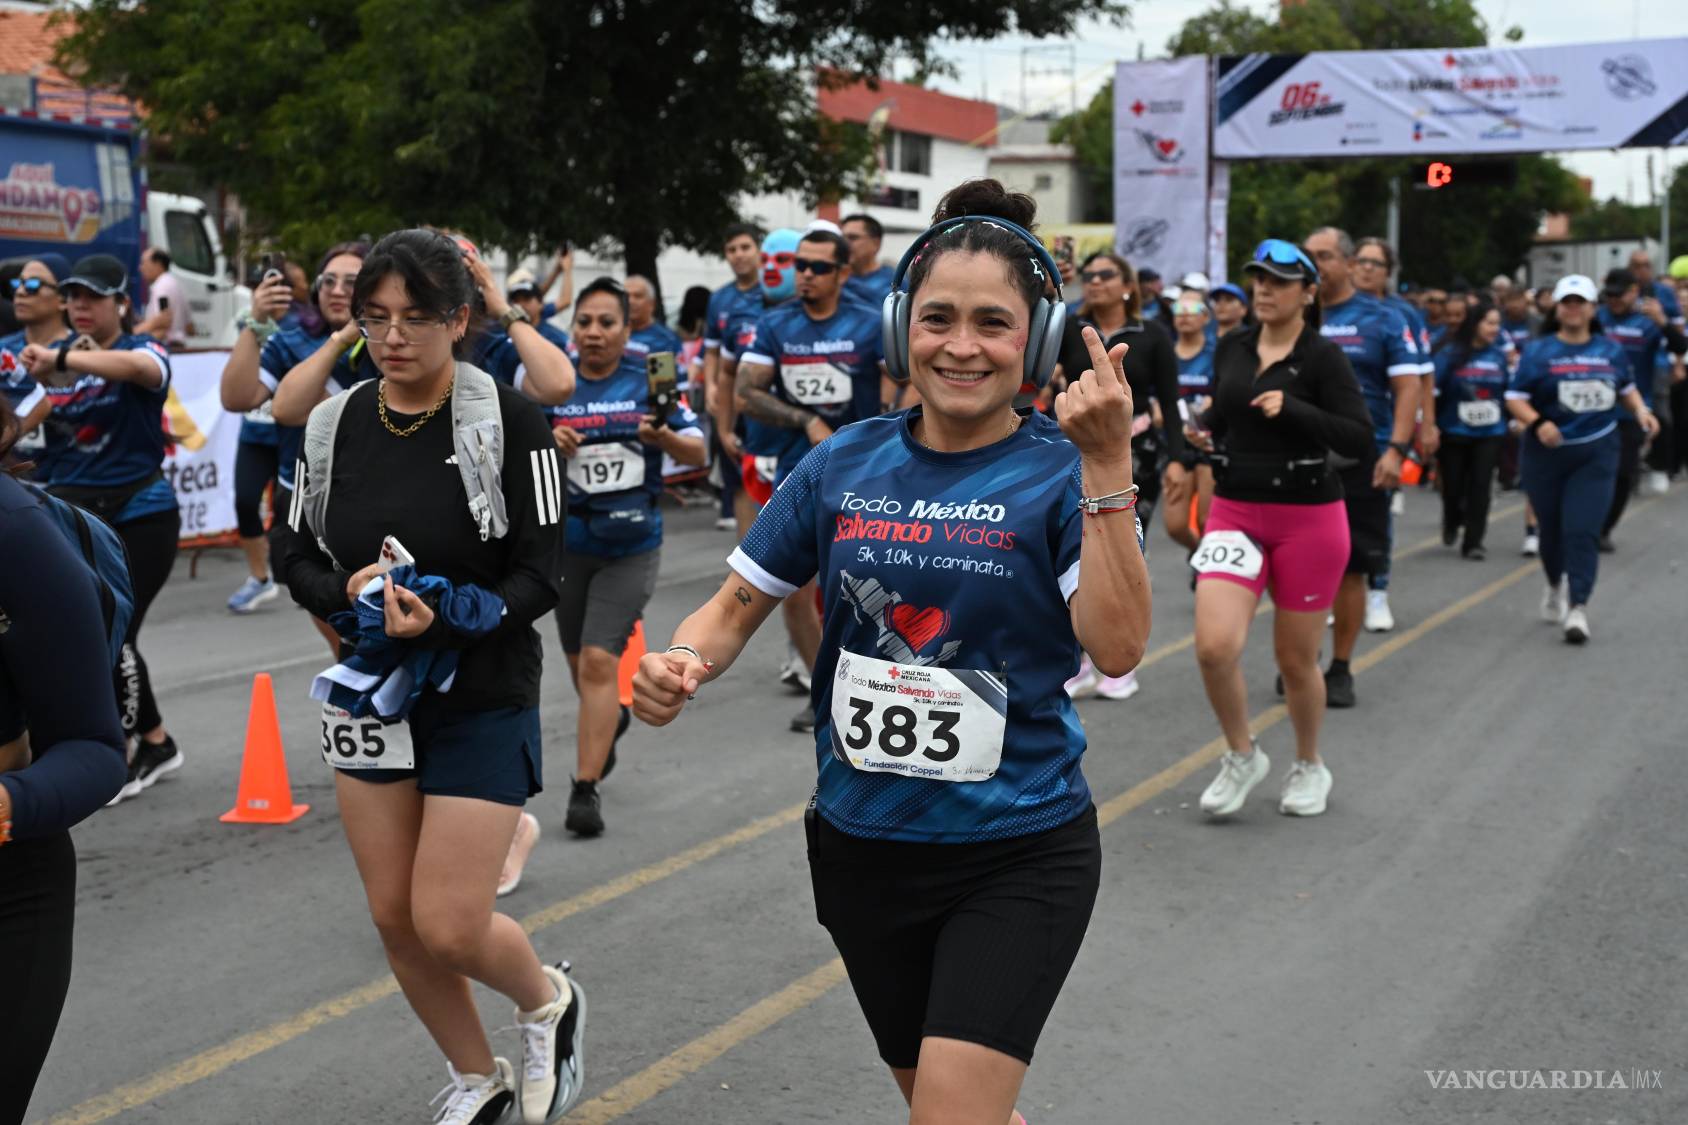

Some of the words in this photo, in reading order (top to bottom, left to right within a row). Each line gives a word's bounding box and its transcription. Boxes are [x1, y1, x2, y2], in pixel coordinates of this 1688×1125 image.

[1281, 82, 1321, 112] 06
[796, 378, 836, 397] 524
[166, 461, 218, 494] teca
[581, 461, 625, 485] 197
[842, 492, 901, 514] Todo
[909, 499, 1005, 522] México
[834, 512, 933, 543] Salvando
[944, 522, 1016, 550] Vidas
[857, 546, 879, 567] 5k,
[885, 549, 914, 565] 10k
[920, 555, 930, 571] y
[1199, 546, 1246, 567] 502
[901, 669, 916, 677] CRUZ
[917, 671, 932, 679] ROJA
[901, 675, 931, 683] MEXICANA
[851, 675, 867, 687] Todo
[868, 680, 896, 694] México
[897, 685, 935, 699] Salvando
[938, 690, 962, 699] Vidas
[322, 720, 386, 758] 365
[845, 696, 960, 762] 383
[864, 758, 908, 772] Fundación
[910, 764, 943, 777] Coppel
